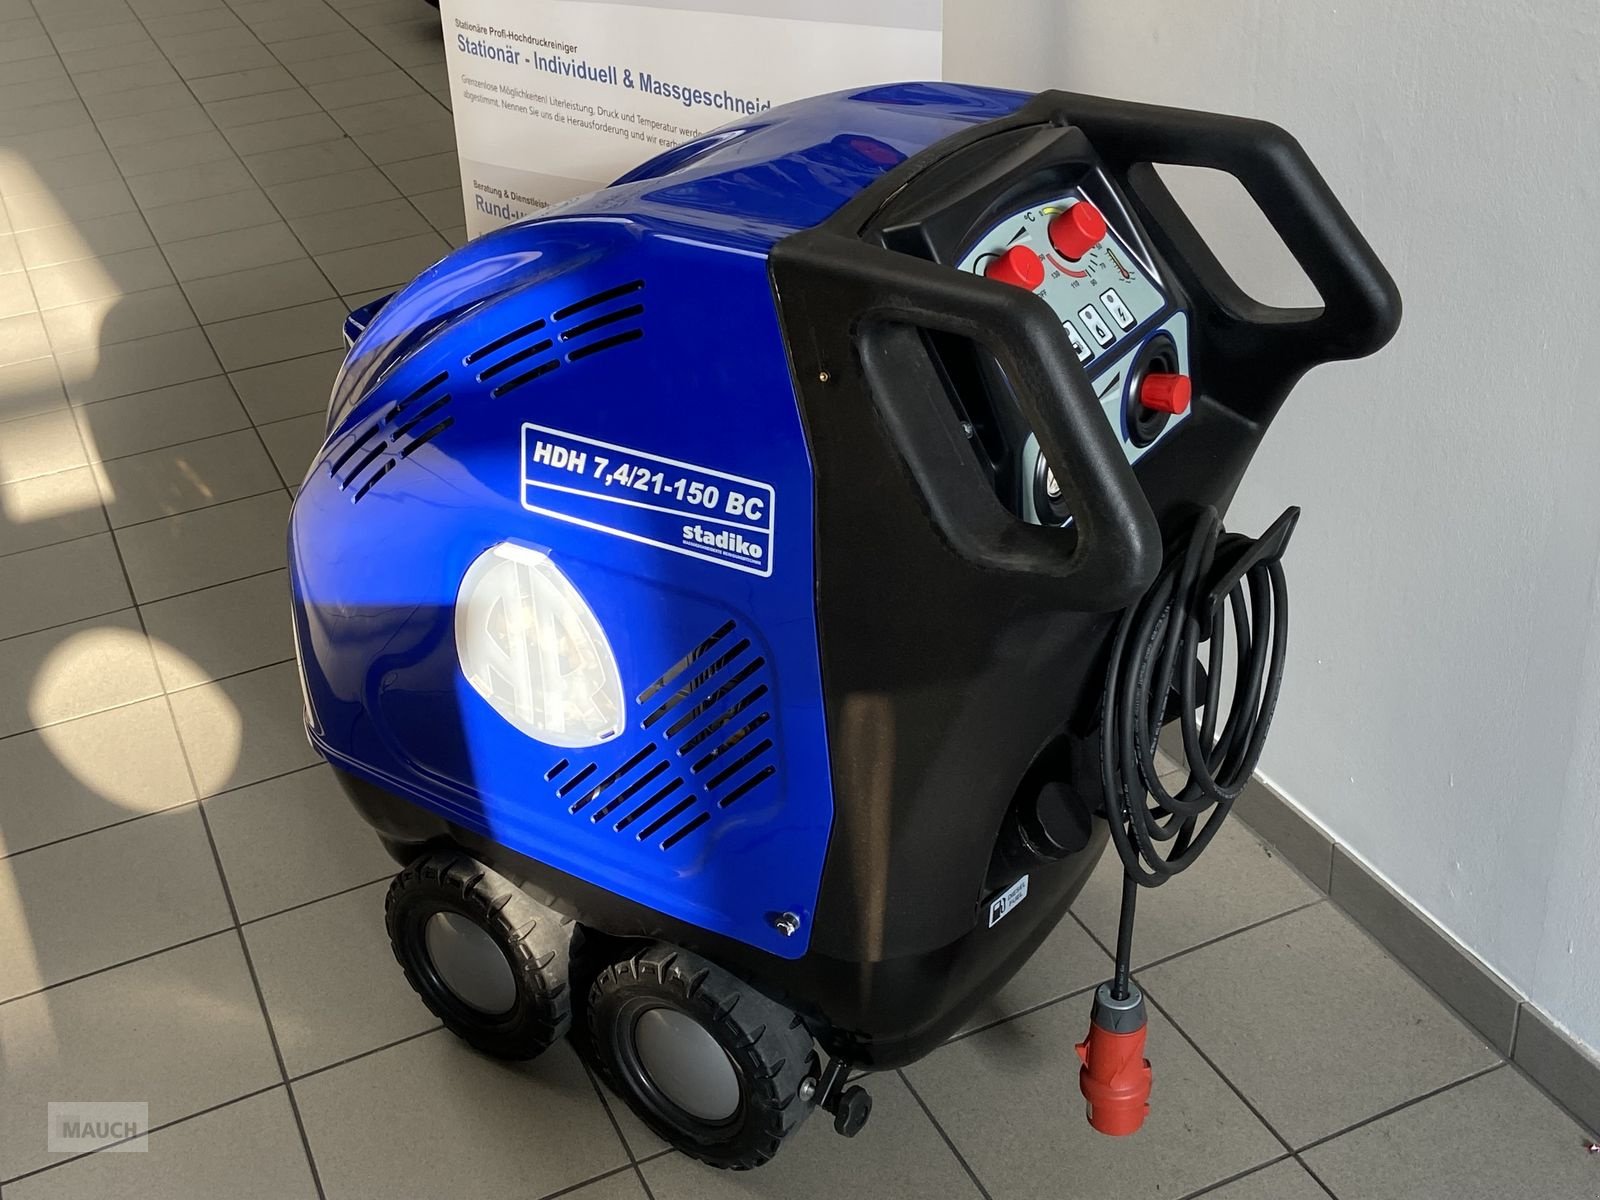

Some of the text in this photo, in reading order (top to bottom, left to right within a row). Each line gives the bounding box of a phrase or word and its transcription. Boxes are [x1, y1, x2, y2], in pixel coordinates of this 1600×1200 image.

[455, 18, 578, 54] Stationäre Profi-Hochdruckreiniger
[457, 34, 520, 64] Stationär
[534, 51, 617, 85] Individuell
[623, 69, 634, 88] &
[461, 74, 498, 93] Grenzenlose
[499, 84, 547, 104] Möglichkeiten!
[597, 106, 618, 119] Druck
[621, 113, 635, 123] und
[637, 115, 677, 133] Temperatur
[501, 100, 528, 114] Nennen
[529, 105, 539, 117] Sie
[541, 111, 553, 120] uns
[554, 112, 565, 123] die
[567, 115, 629, 139] Herausforderung
[631, 130, 645, 141] und
[646, 134, 657, 143] wir
[473, 180, 502, 199] Beratung
[504, 189, 509, 199] &
[533, 441, 764, 521] HDH 7,4/21-150 BC
[682, 524, 763, 559] stadiko
